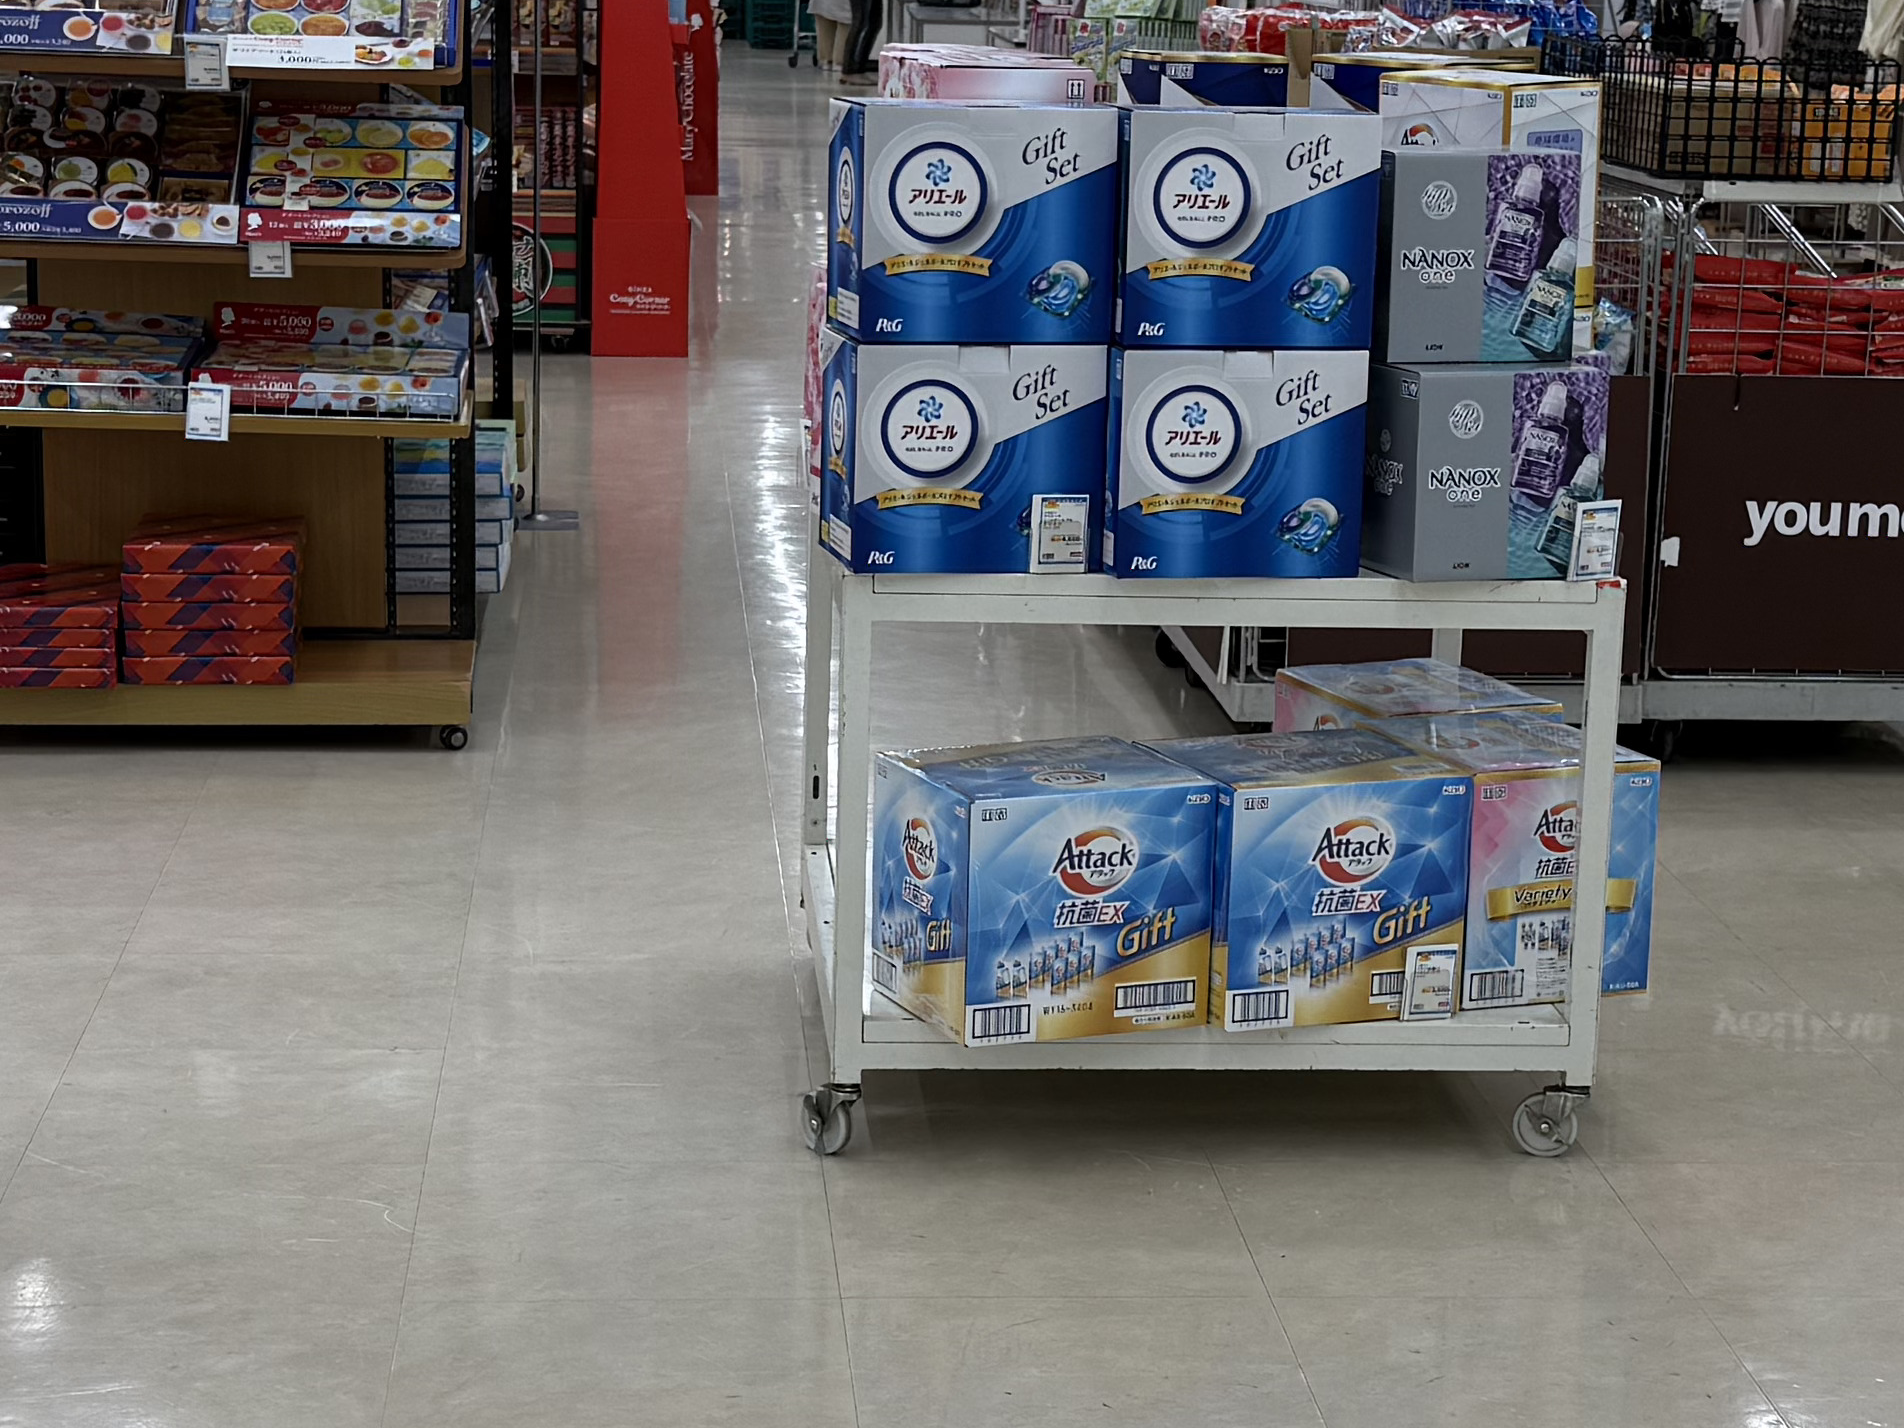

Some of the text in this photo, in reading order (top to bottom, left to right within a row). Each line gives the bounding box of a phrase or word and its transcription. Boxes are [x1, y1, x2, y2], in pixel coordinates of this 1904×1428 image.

[1022, 128, 1068, 165] Gift
[1286, 134, 1332, 171] Gift
[1045, 152, 1080, 184] Set
[1308, 159, 1344, 191] Set
[908, 189, 967, 205] アリエール
[1173, 194, 1230, 210] アリエール
[1401, 248, 1474, 270] NANOX
[1418, 269, 1455, 284] one
[1012, 364, 1058, 401] Gift
[1035, 388, 1070, 421] Set
[901, 425, 957, 441] アリエール
[1165, 430, 1221, 446] アリエール
[1429, 467, 1501, 489] NANOX
[1446, 487, 1482, 503] one
[1051, 837, 1135, 875] Attack
[1310, 827, 1391, 863] Attack
[1056, 900, 1127, 927] 抗菌EX
[1313, 890, 1382, 914] 抗菌EX
[1116, 907, 1176, 957] Gift
[1372, 897, 1432, 945] Gift
